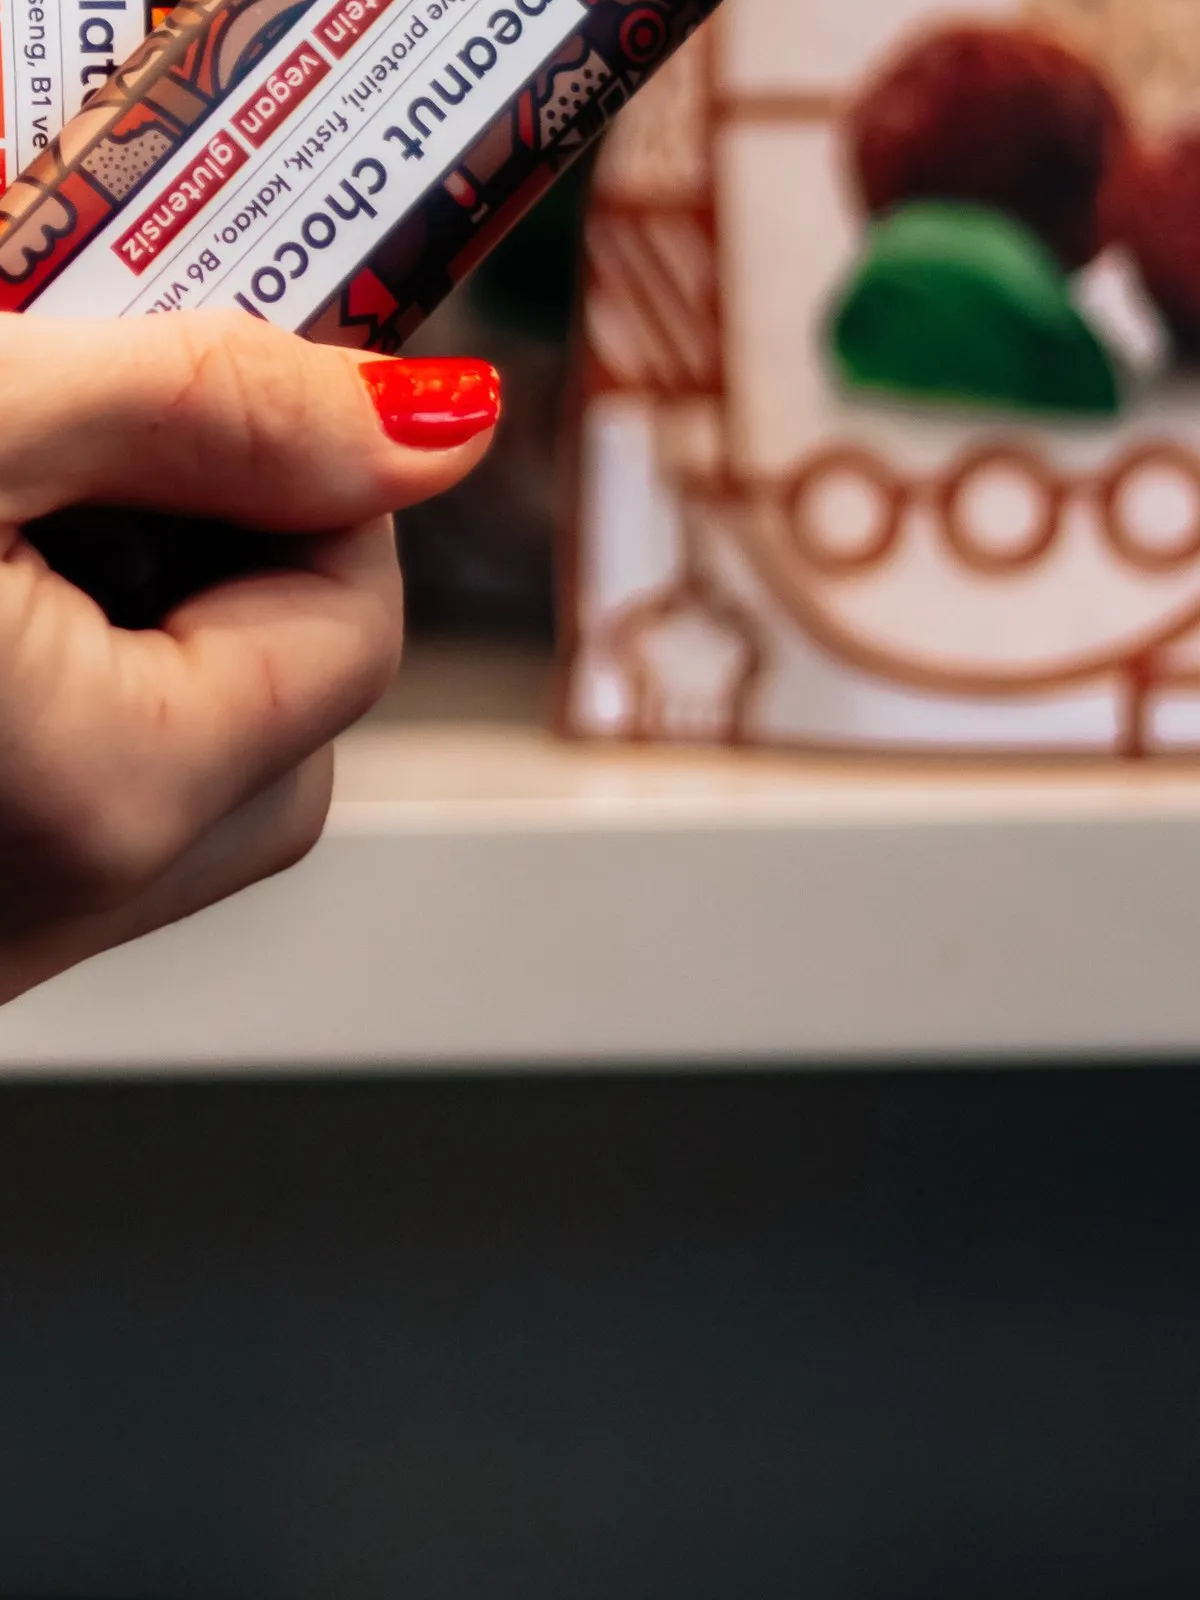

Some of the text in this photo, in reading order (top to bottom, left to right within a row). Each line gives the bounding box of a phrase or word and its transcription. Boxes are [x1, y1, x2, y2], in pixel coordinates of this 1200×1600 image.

[31, 77, 52, 105] B1
[341, 13, 429, 112] proteini,
[239, 55, 320, 134] vegan
[31, 116, 49, 149] ve
[283, 111, 349, 171] fıstık,
[121, 140, 235, 262] glutensiz
[213, 175, 292, 244] kakao,
[186, 248, 222, 283] B6
[146, 282, 189, 314] vit
